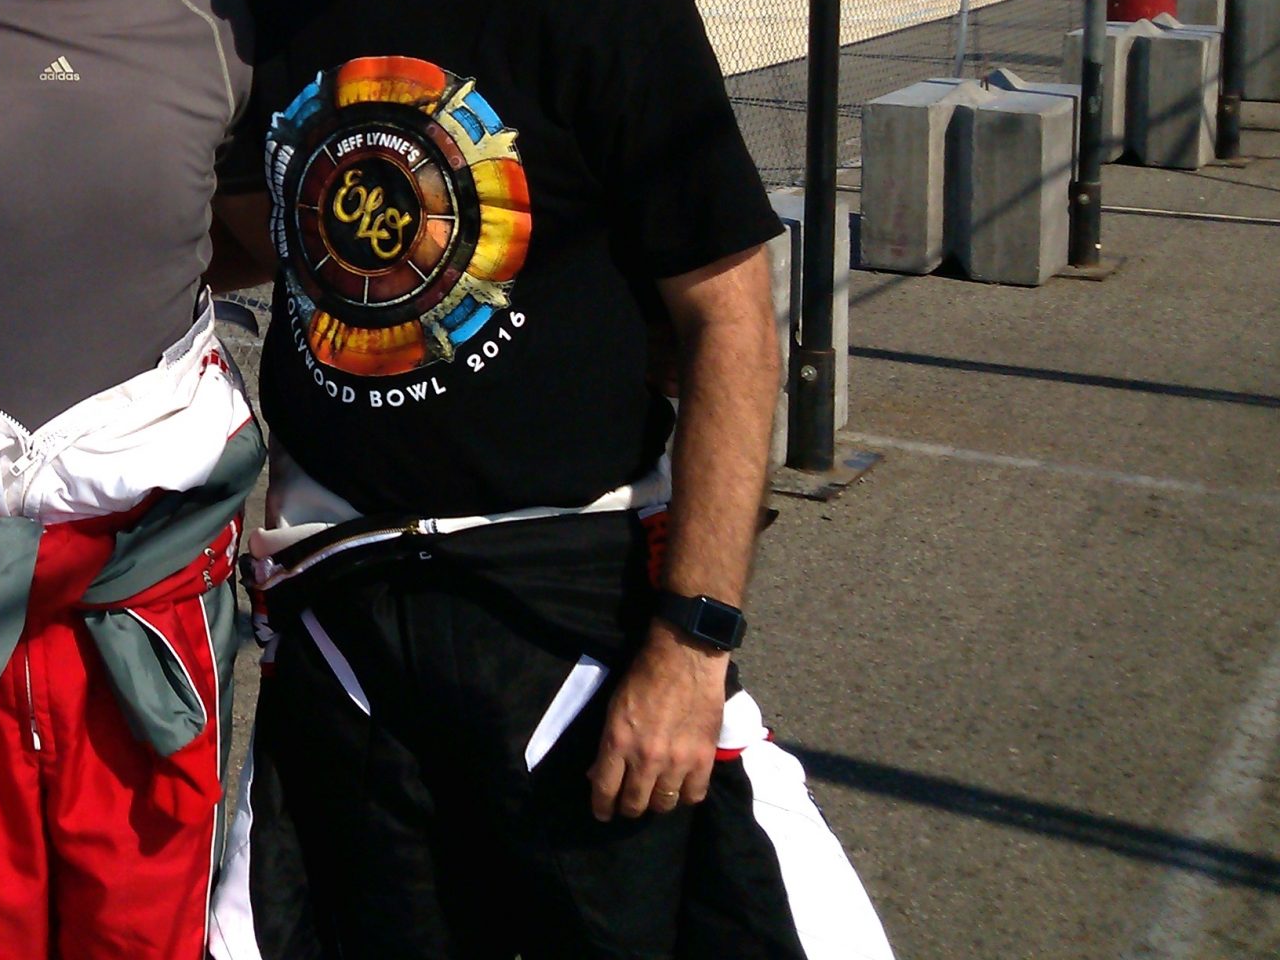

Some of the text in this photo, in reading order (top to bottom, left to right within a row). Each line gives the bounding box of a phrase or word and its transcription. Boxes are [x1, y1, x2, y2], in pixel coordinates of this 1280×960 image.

[39, 69, 81, 81] adidas
[336, 131, 421, 163] JEFF LYNNE'S
[286, 292, 448, 408] OLLYWOOD BOWL
[466, 310, 526, 373] 2016
